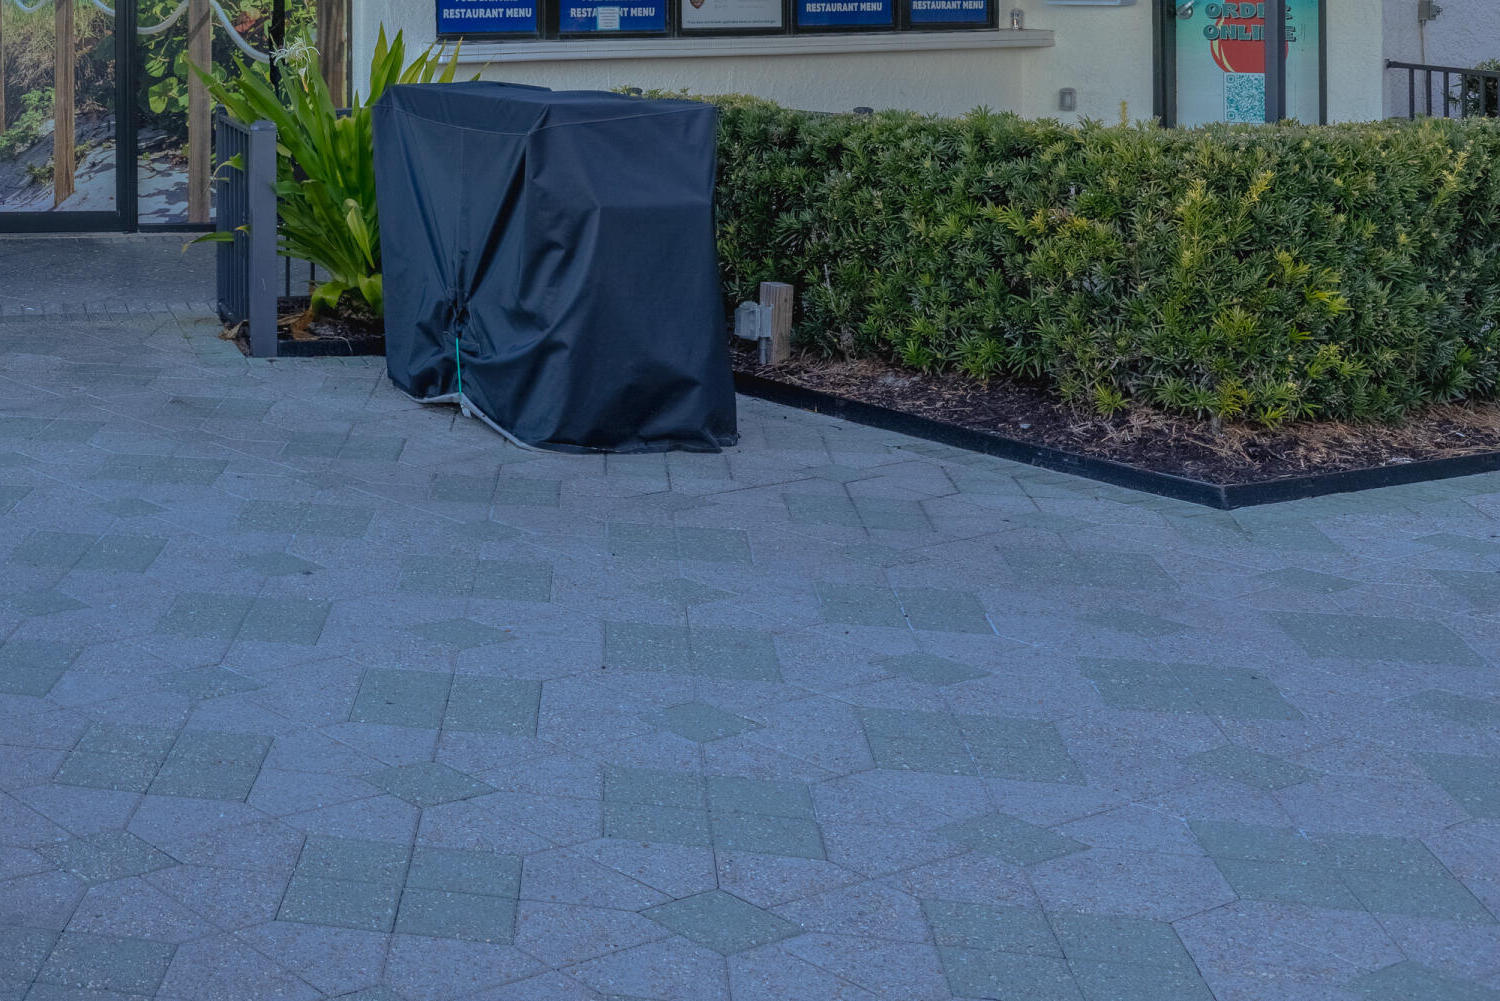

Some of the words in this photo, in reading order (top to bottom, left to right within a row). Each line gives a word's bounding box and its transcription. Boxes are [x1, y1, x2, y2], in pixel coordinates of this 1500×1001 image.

[806, 2, 858, 12] RESTAURANT
[859, 2, 883, 11] MENU
[912, 0, 962, 10] RESTAURANT
[963, 0, 984, 9] MENU
[443, 7, 504, 19] RESTAURANT
[505, 7, 532, 18] MENU
[630, 7, 655, 17] MENU
[1205, 2, 1293, 20] ORD
[1202, 24, 1297, 42] ONLIE
